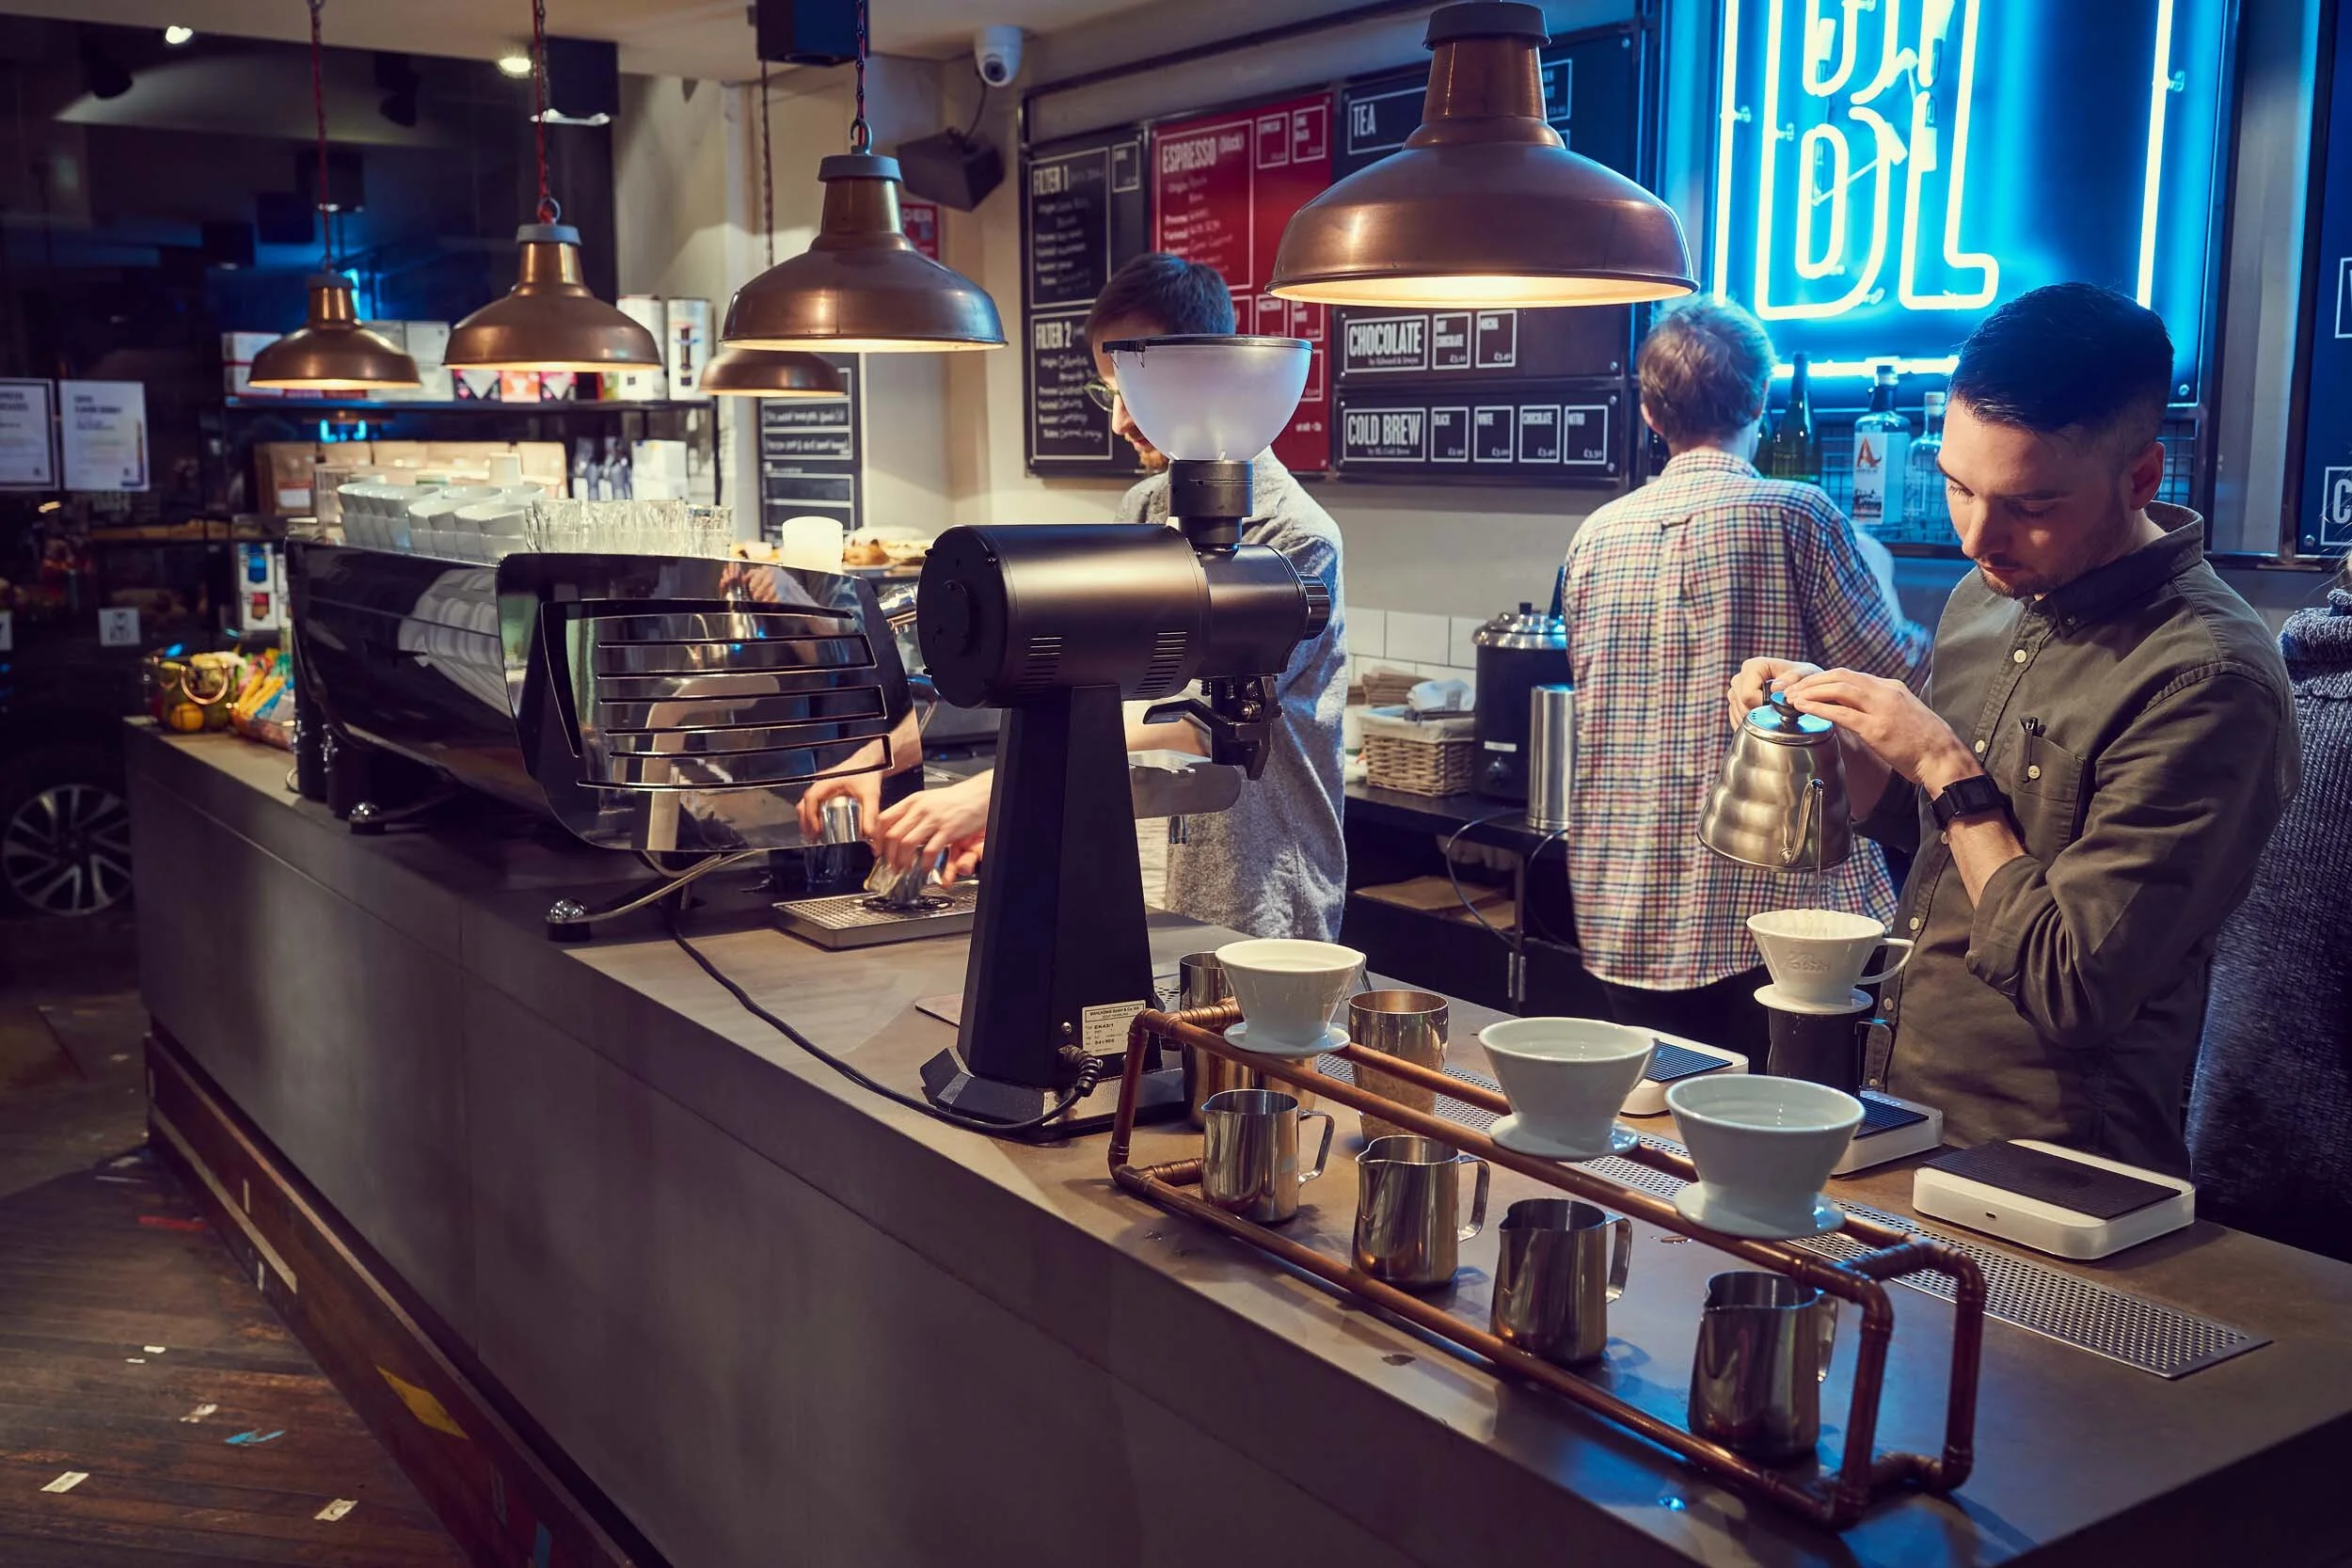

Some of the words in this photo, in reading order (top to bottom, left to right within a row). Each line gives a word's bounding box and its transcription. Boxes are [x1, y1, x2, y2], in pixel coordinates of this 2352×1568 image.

[1353, 103, 1376, 137] TEA
[1162, 136, 1216, 174] ESPRESSO
[1063, 165, 1069, 191] 1
[1036, 323, 1063, 350] FILTER
[1064, 321, 1073, 348] 2
[1348, 322, 1422, 356] CHOCOLATE
[1347, 414, 1379, 446] COLD
[1383, 414, 1422, 446] BREW
[1522, 412, 1552, 425] CHOCOLATE
